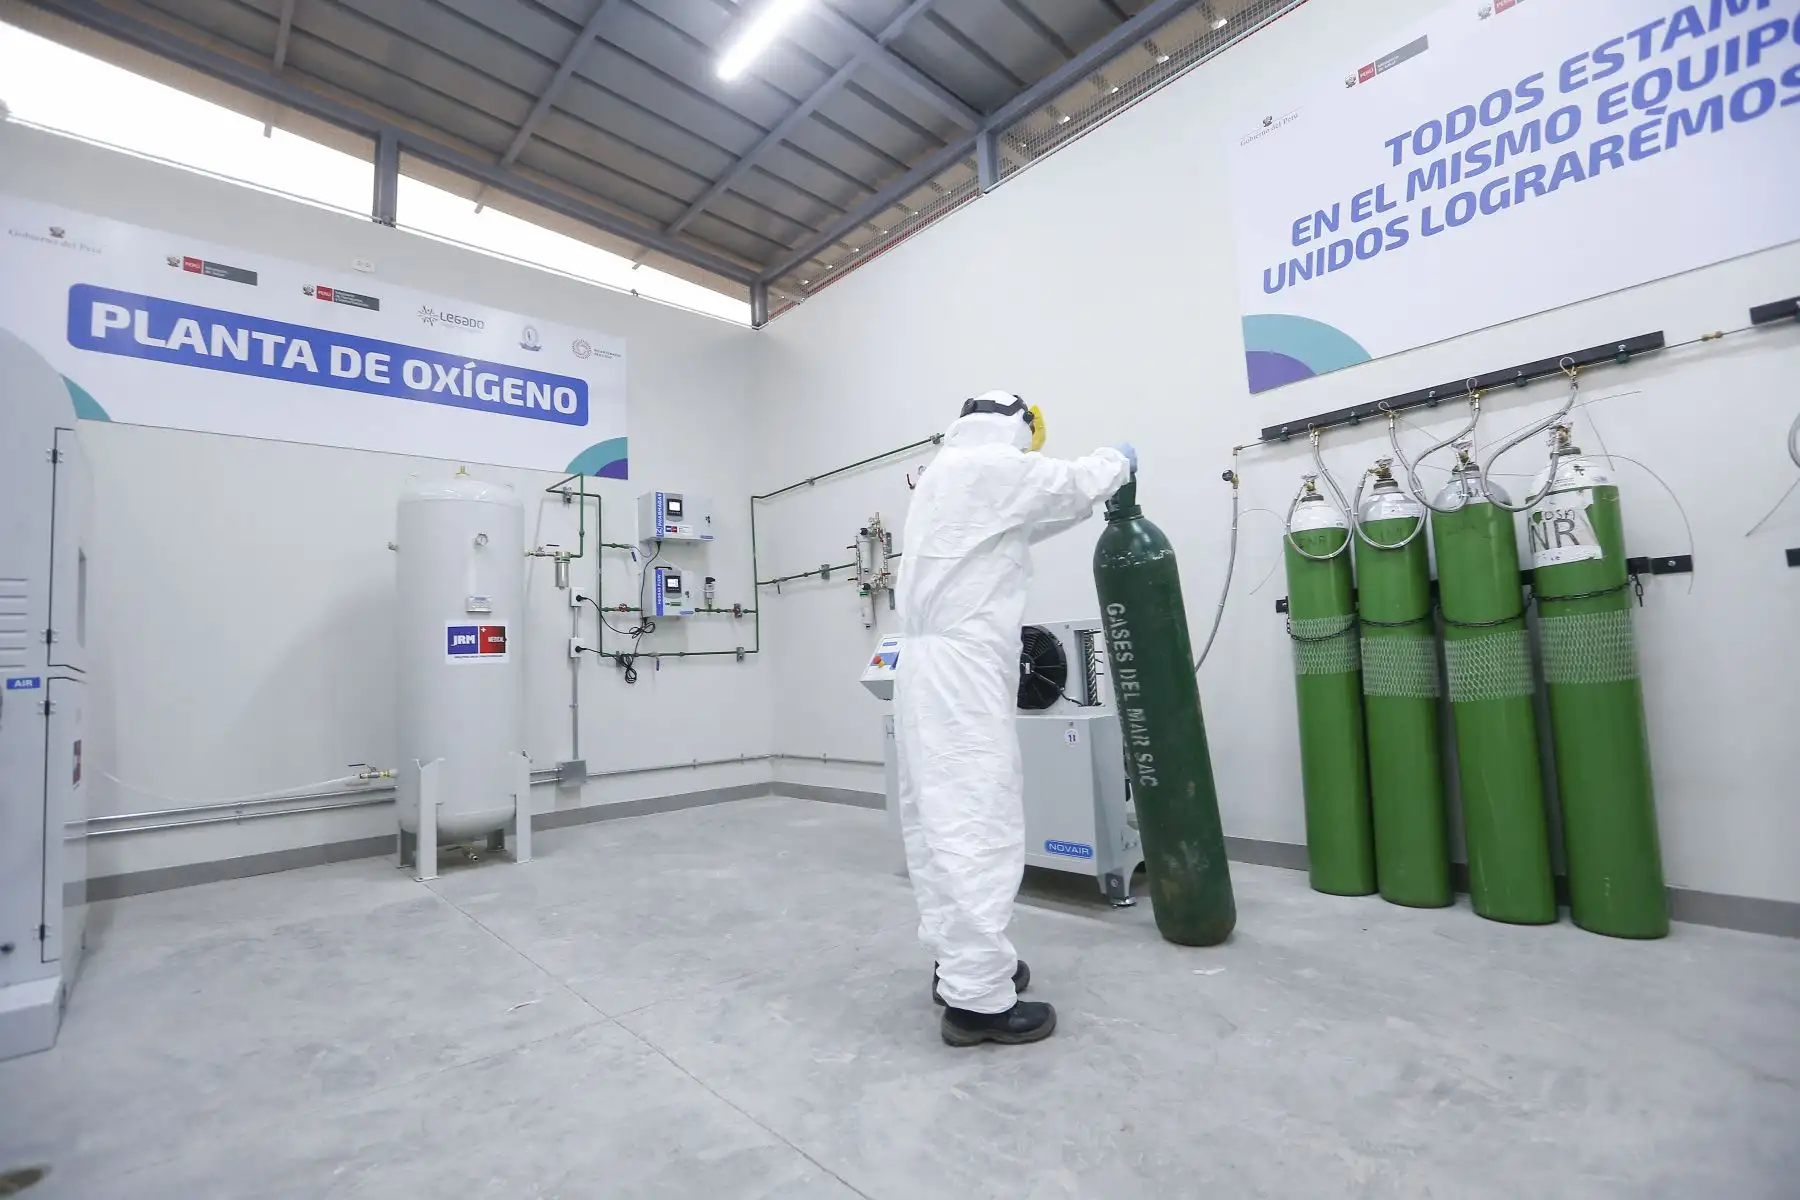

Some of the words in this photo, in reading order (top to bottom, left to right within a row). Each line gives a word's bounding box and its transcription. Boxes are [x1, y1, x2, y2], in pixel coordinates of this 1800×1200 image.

[1291, 202, 1340, 247] EN
[1350, 183, 1397, 225] EL
[1405, 104, 1582, 203] MISMO
[1597, 10, 1800, 125] EQUIP
[1384, 71, 1545, 168] TODOS
[1262, 215, 1410, 295] UNIDOS
[90, 301, 319, 374] PLANTA
[330, 345, 390, 384] DE
[402, 361, 578, 415] OXÍGENO
[451, 634, 476, 647] JRM
[1106, 602, 1135, 663] GASES
[14, 679, 33, 688] AIR
[1119, 668, 1141, 702] DEL
[1126, 708, 1150, 748] MAR
[1134, 752, 1159, 788] SAC
[1048, 843, 1089, 855] NOVAIR
